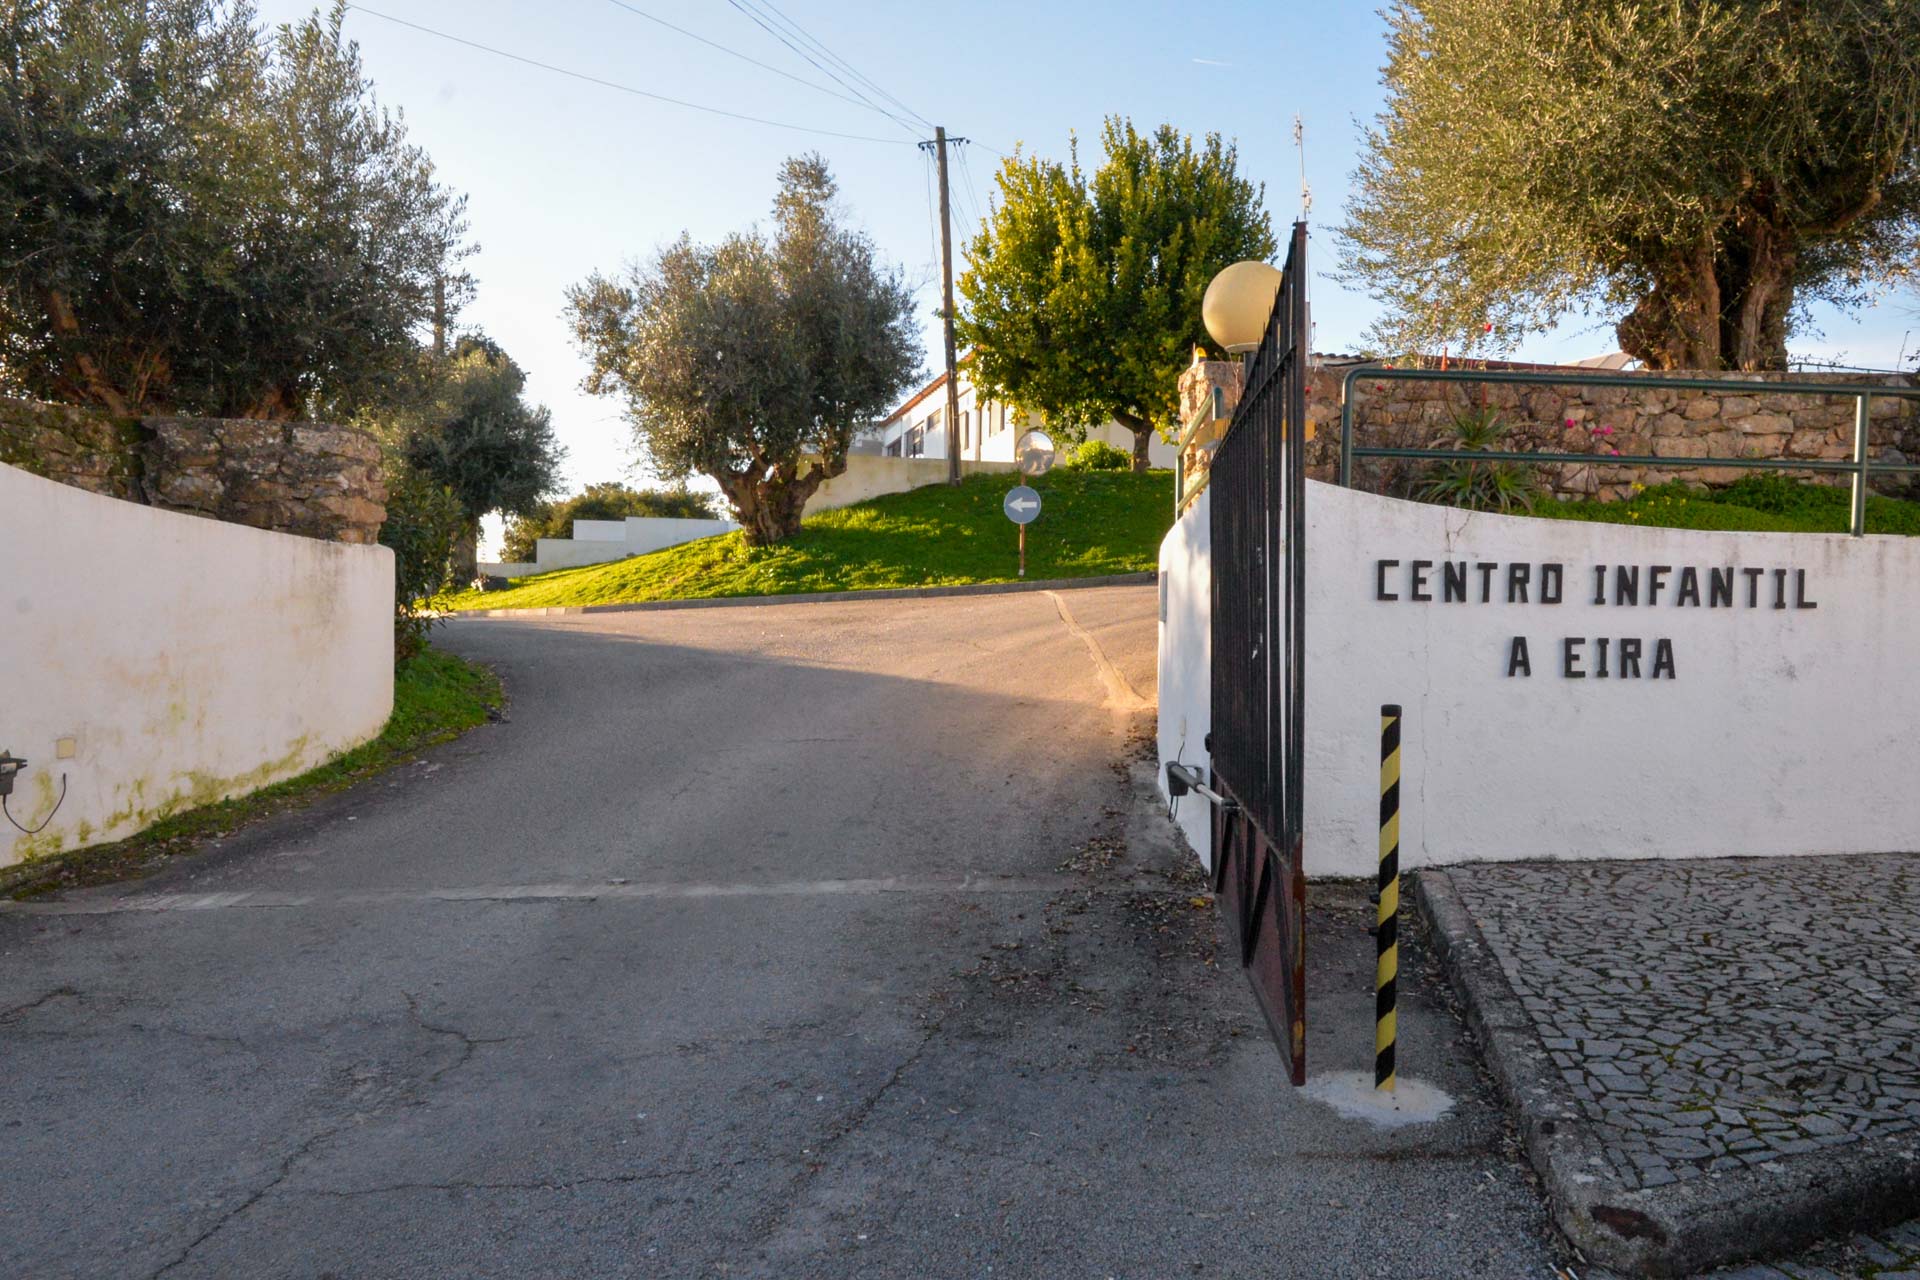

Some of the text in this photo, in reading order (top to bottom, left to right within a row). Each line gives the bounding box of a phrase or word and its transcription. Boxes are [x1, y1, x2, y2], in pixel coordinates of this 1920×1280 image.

[1377, 559, 1818, 610] CENTRO INFANTIL
[1508, 636, 1676, 680] A EIRA
